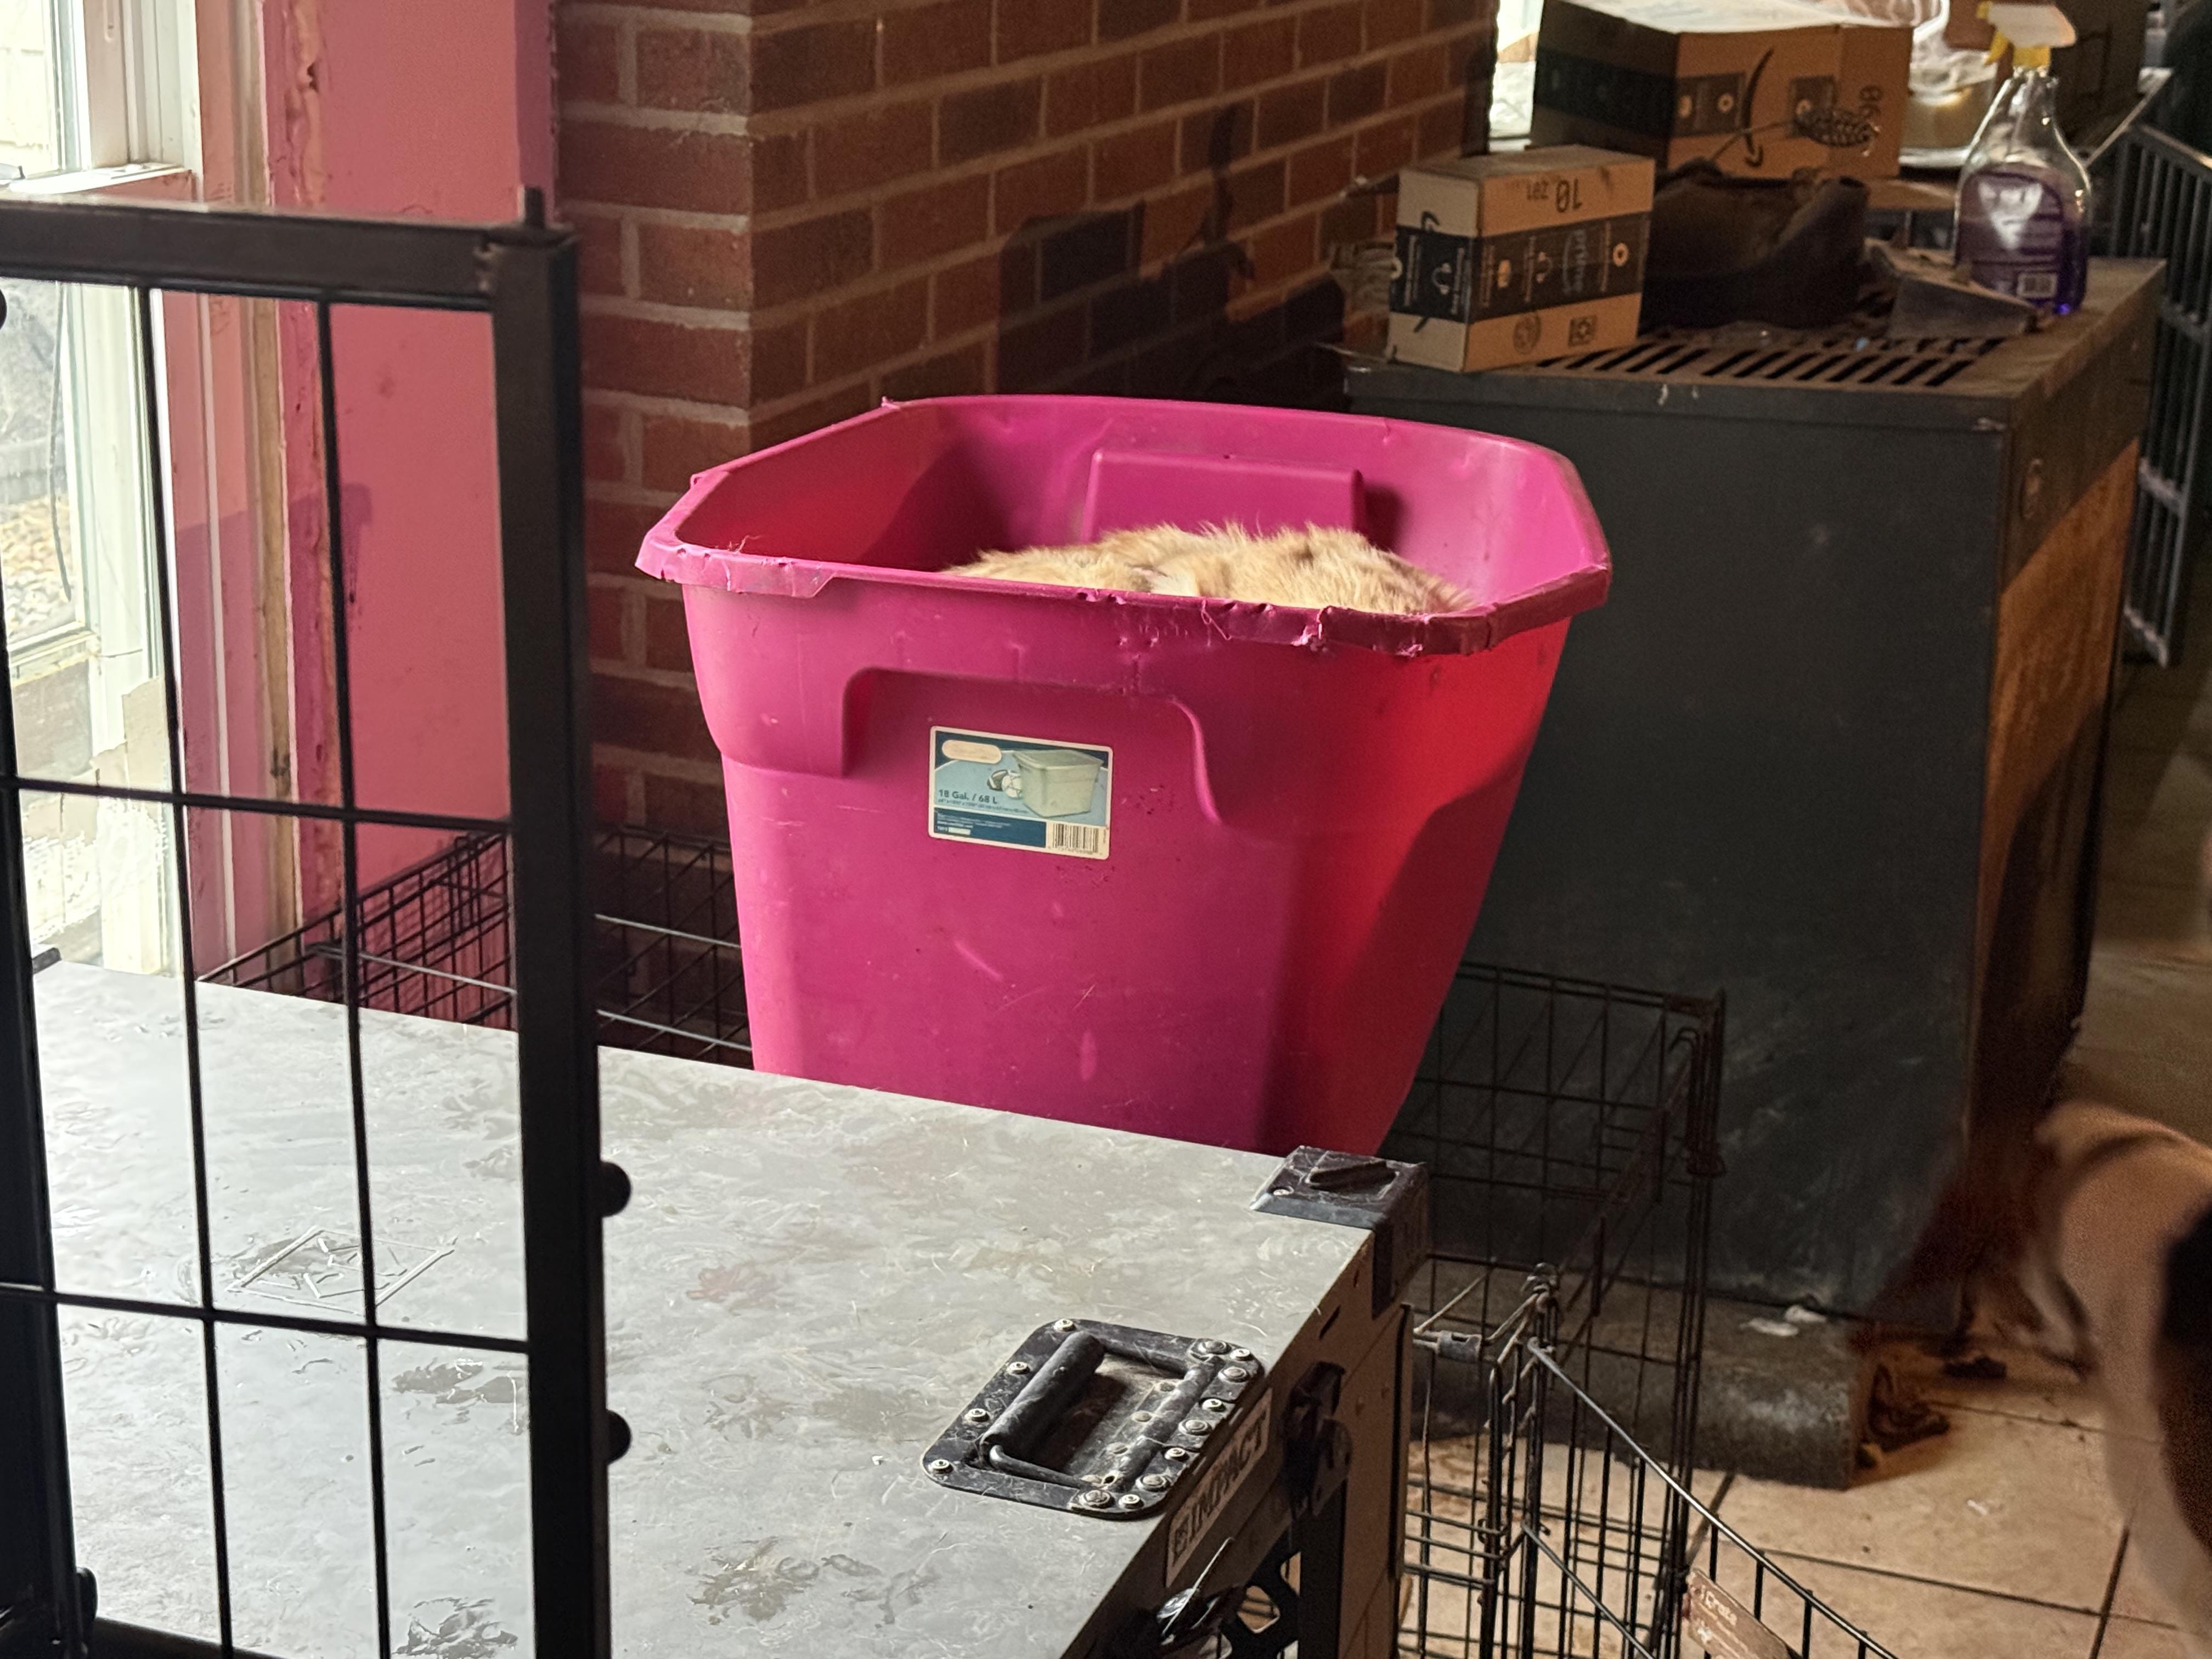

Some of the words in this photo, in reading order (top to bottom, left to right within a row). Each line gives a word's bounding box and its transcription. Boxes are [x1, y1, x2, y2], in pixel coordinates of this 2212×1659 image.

[939, 789, 949, 798] 18
[952, 791, 970, 800] Gal.
[972, 793, 977, 802] /
[979, 795, 990, 803] 68
[992, 797, 997, 805] L
